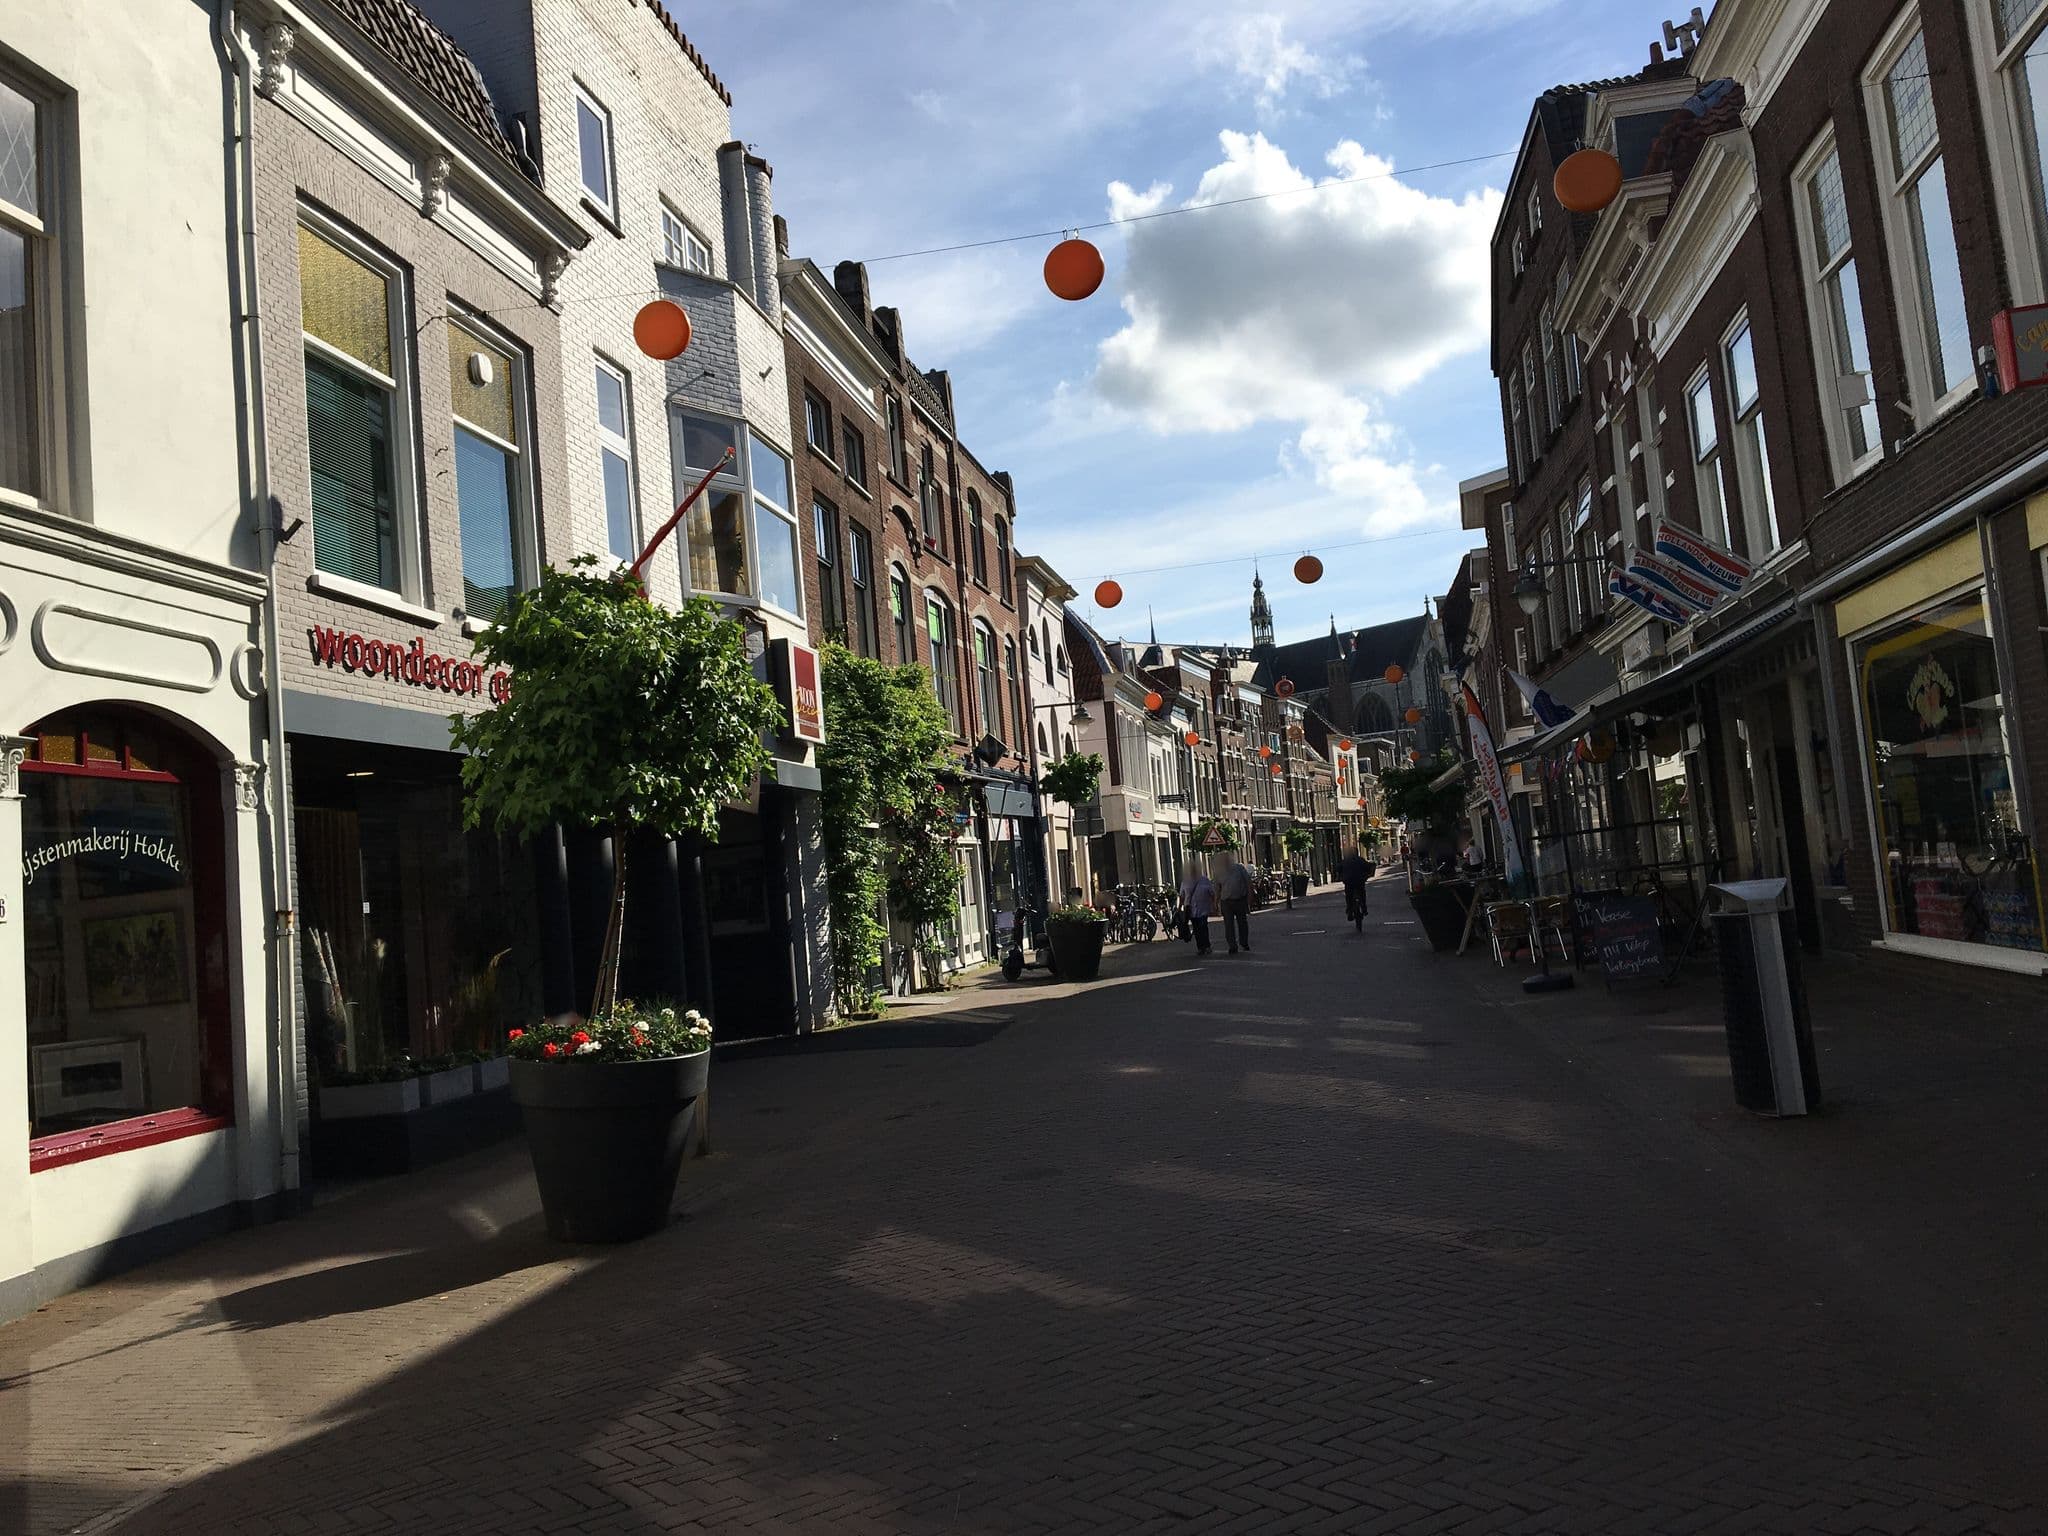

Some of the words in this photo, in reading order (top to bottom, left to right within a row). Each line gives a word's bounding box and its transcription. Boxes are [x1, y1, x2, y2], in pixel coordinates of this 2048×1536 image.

[1657, 532, 1708, 565] HOLLANDSE
[1707, 562, 1743, 584] NIEUWE
[306, 624, 486, 698] woondecor
